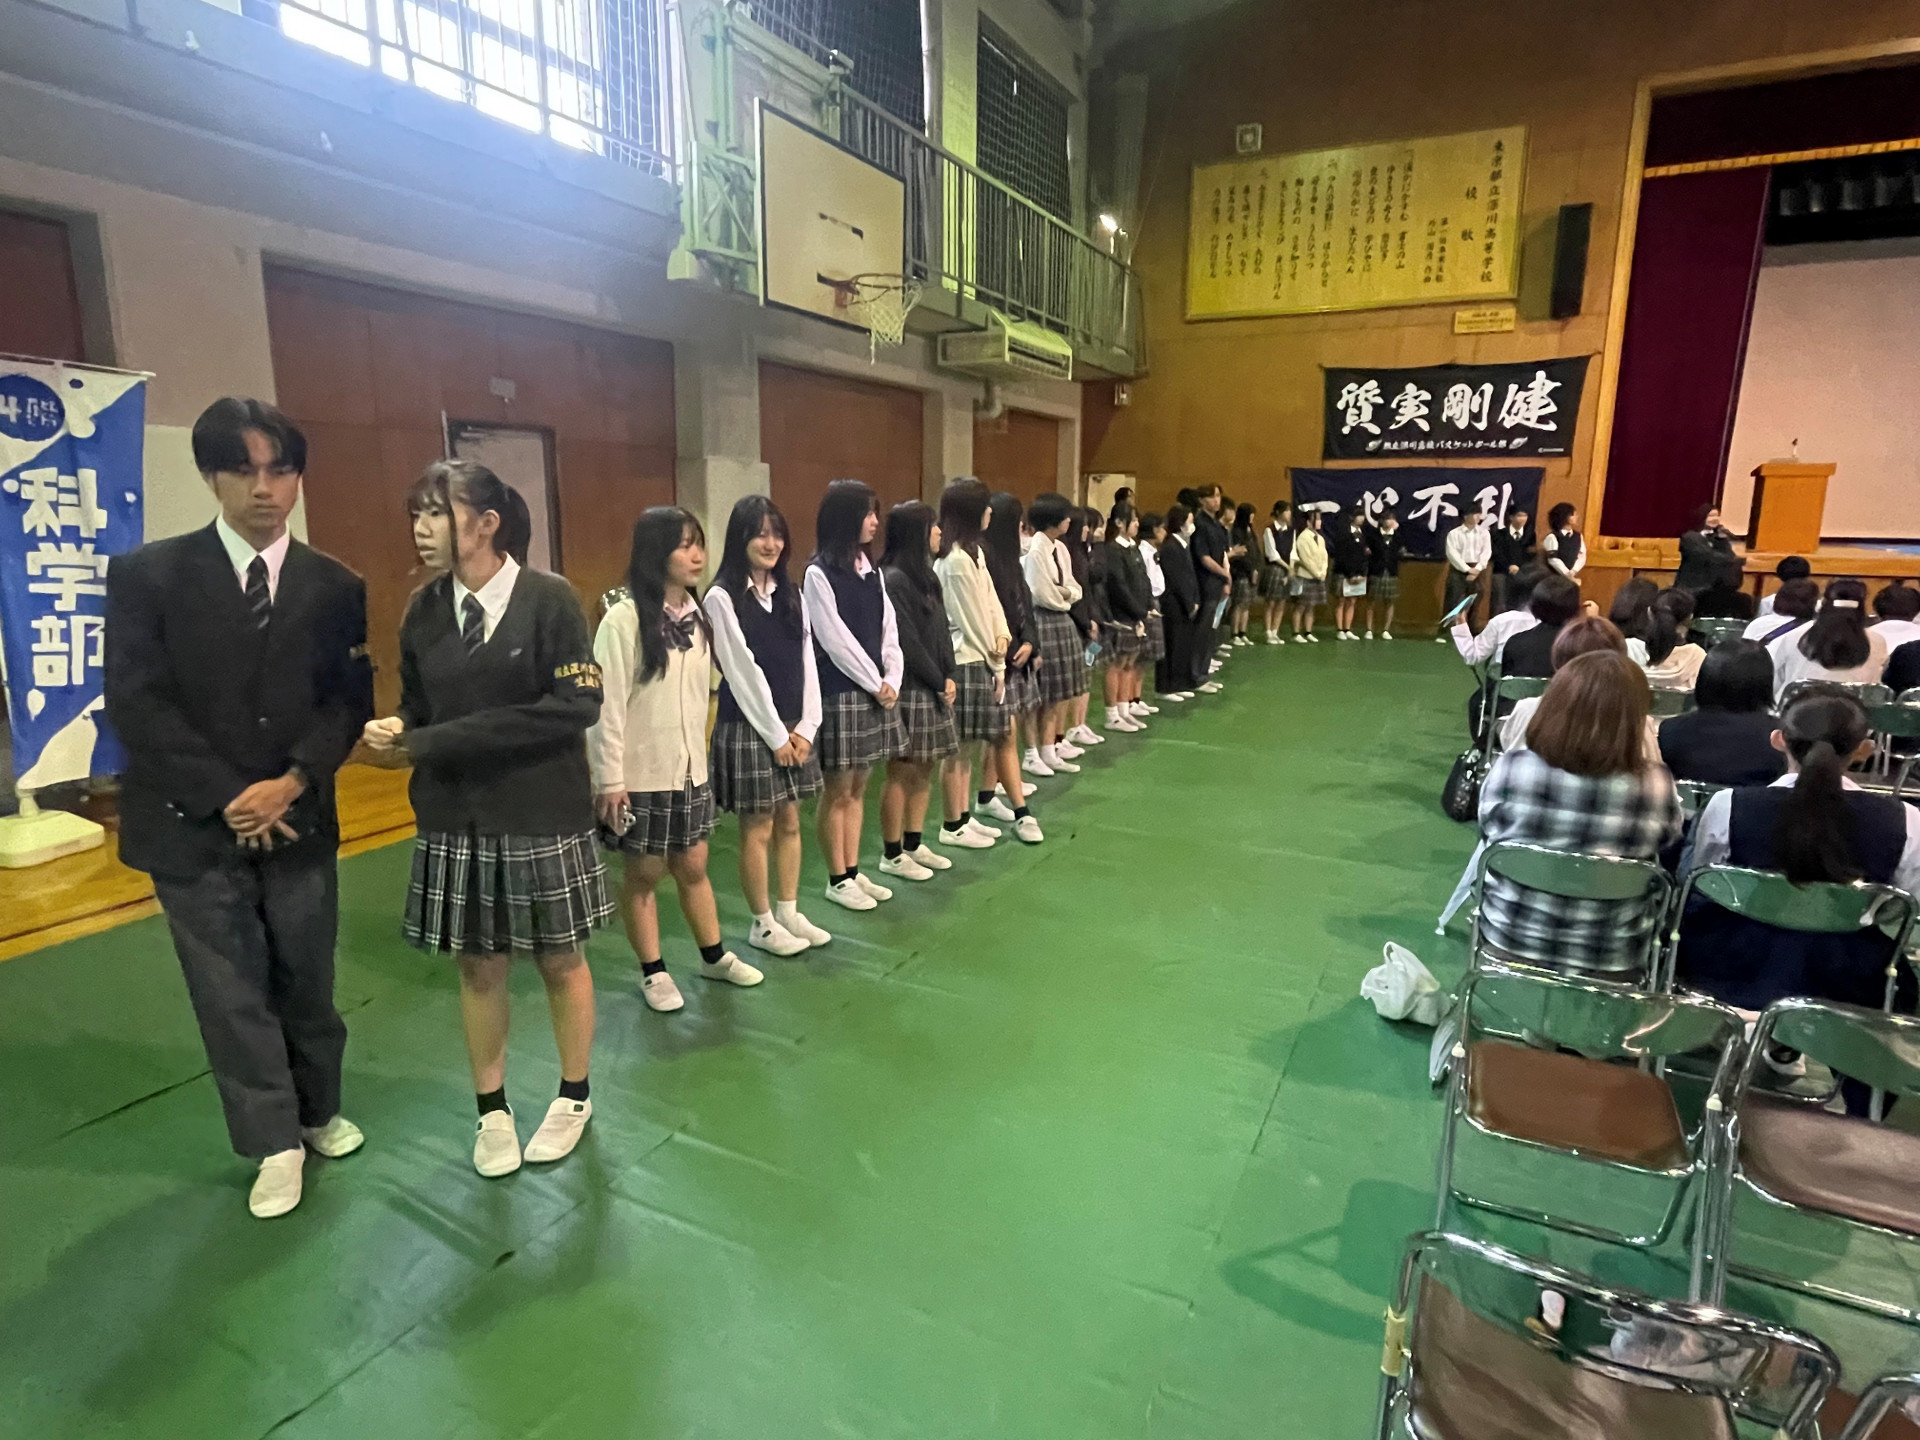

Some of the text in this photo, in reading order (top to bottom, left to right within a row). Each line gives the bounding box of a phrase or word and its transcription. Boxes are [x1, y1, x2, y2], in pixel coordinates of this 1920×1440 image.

[1337, 370, 1563, 435] 質実剛健
[20, 467, 110, 688] 科学部
